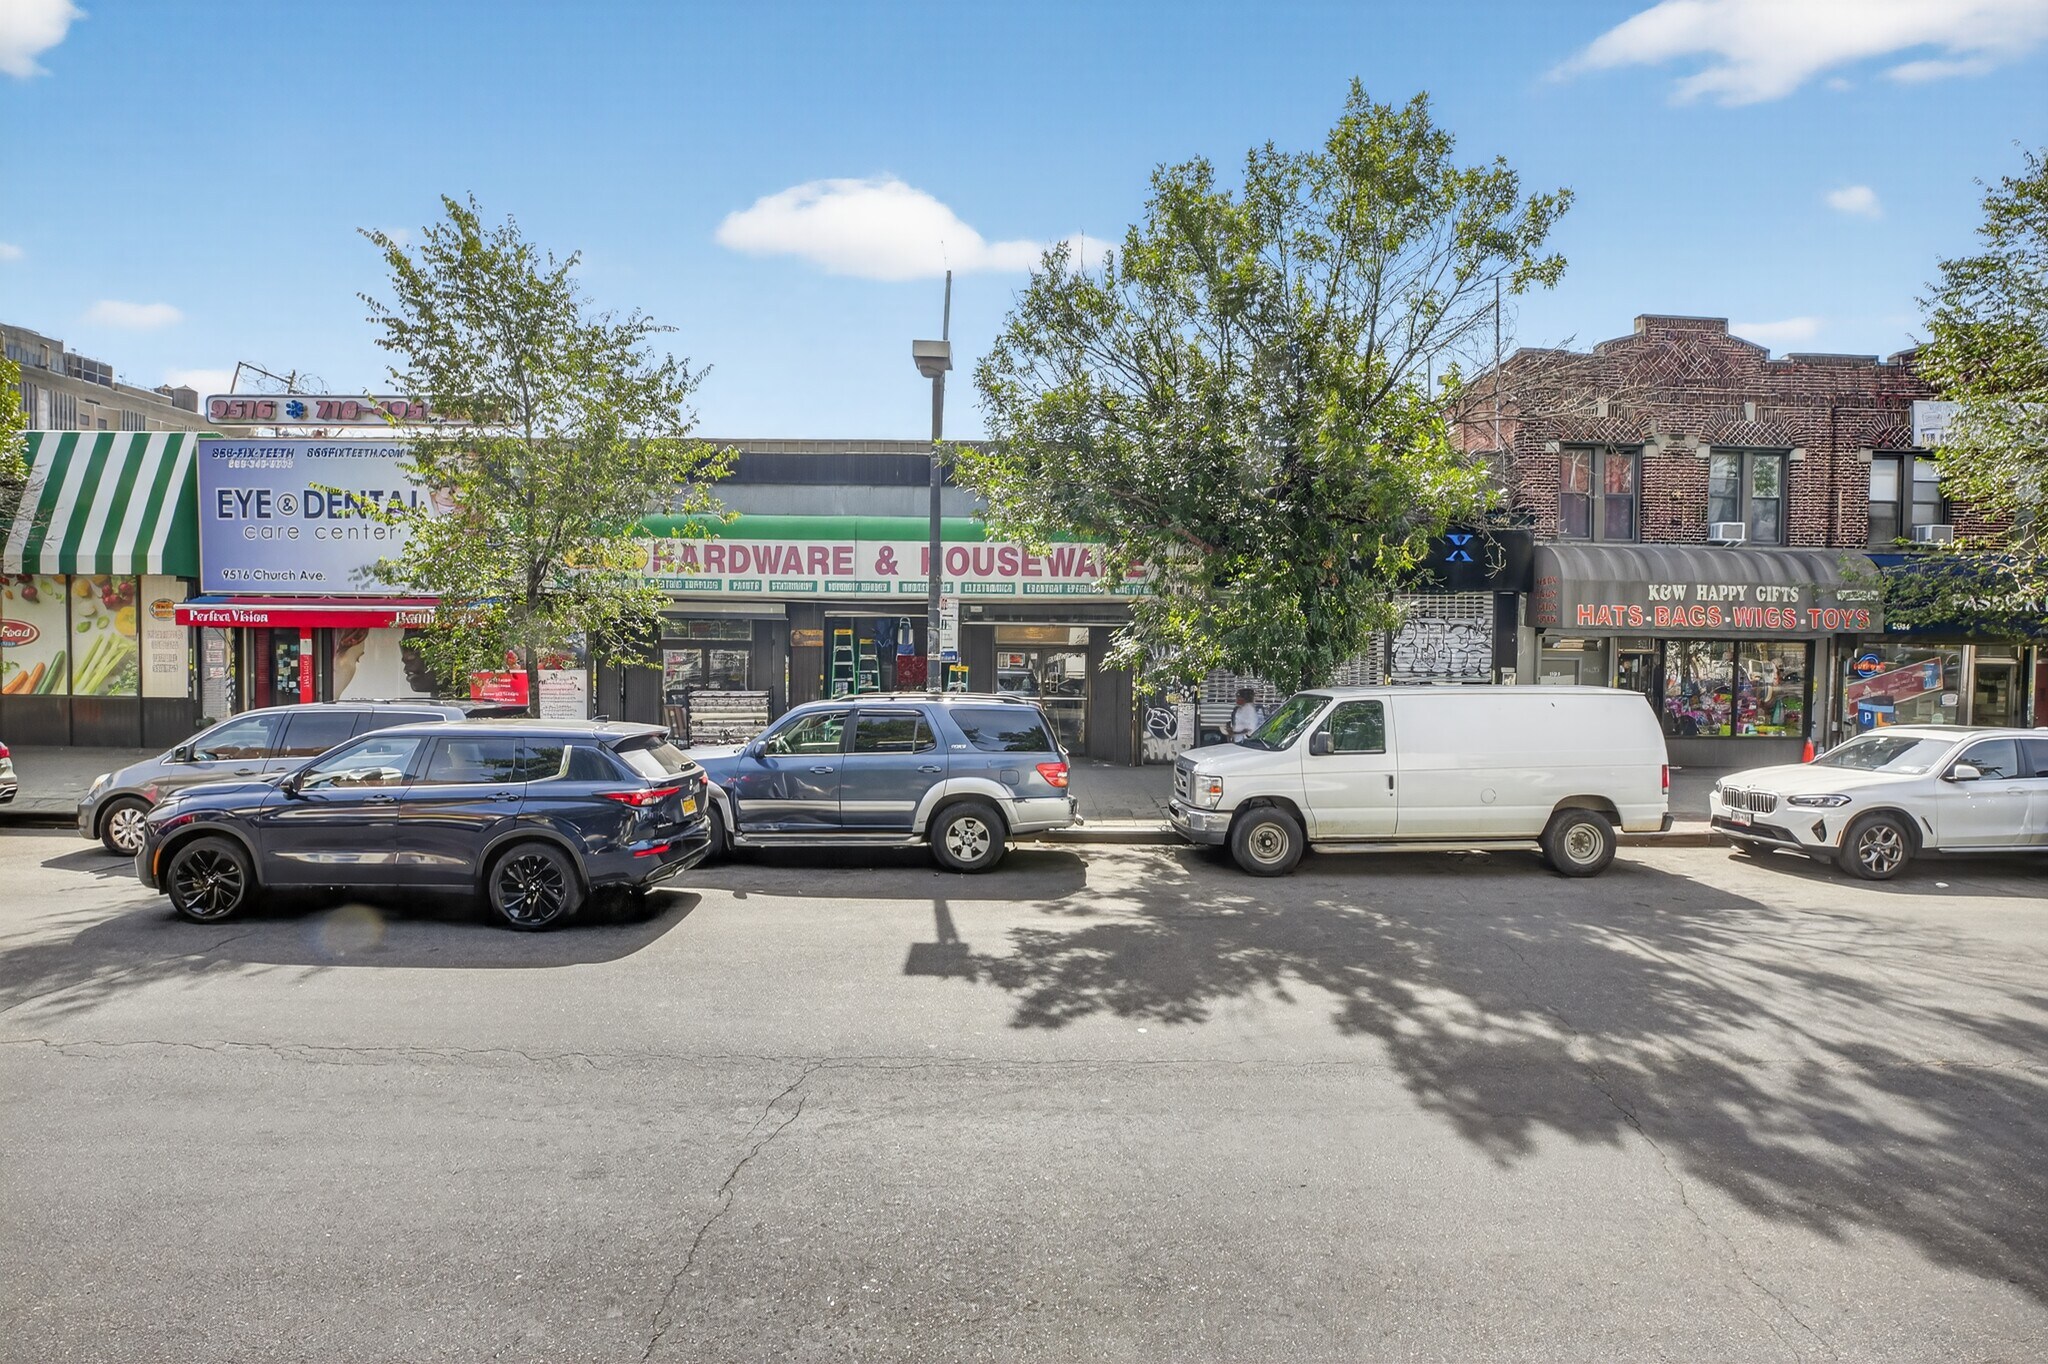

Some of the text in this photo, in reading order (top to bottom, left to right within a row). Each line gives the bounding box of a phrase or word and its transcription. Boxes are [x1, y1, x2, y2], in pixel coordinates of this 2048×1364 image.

[210, 400, 275, 419] 9516
[217, 489, 271, 519] EYE
[279, 496, 296, 513] &
[244, 524, 395, 540] care center
[652, 544, 854, 575] HARDWARE
[875, 545, 899, 575] &
[222, 569, 327, 581] 9516 Church Ave.
[1649, 584, 1799, 602] K&W HAPPY GIFTS
[189, 609, 231, 622] Perfect
[232, 609, 269, 622] Vision
[1577, 604, 1870, 630] HATS BAGS WIGS TOYS
